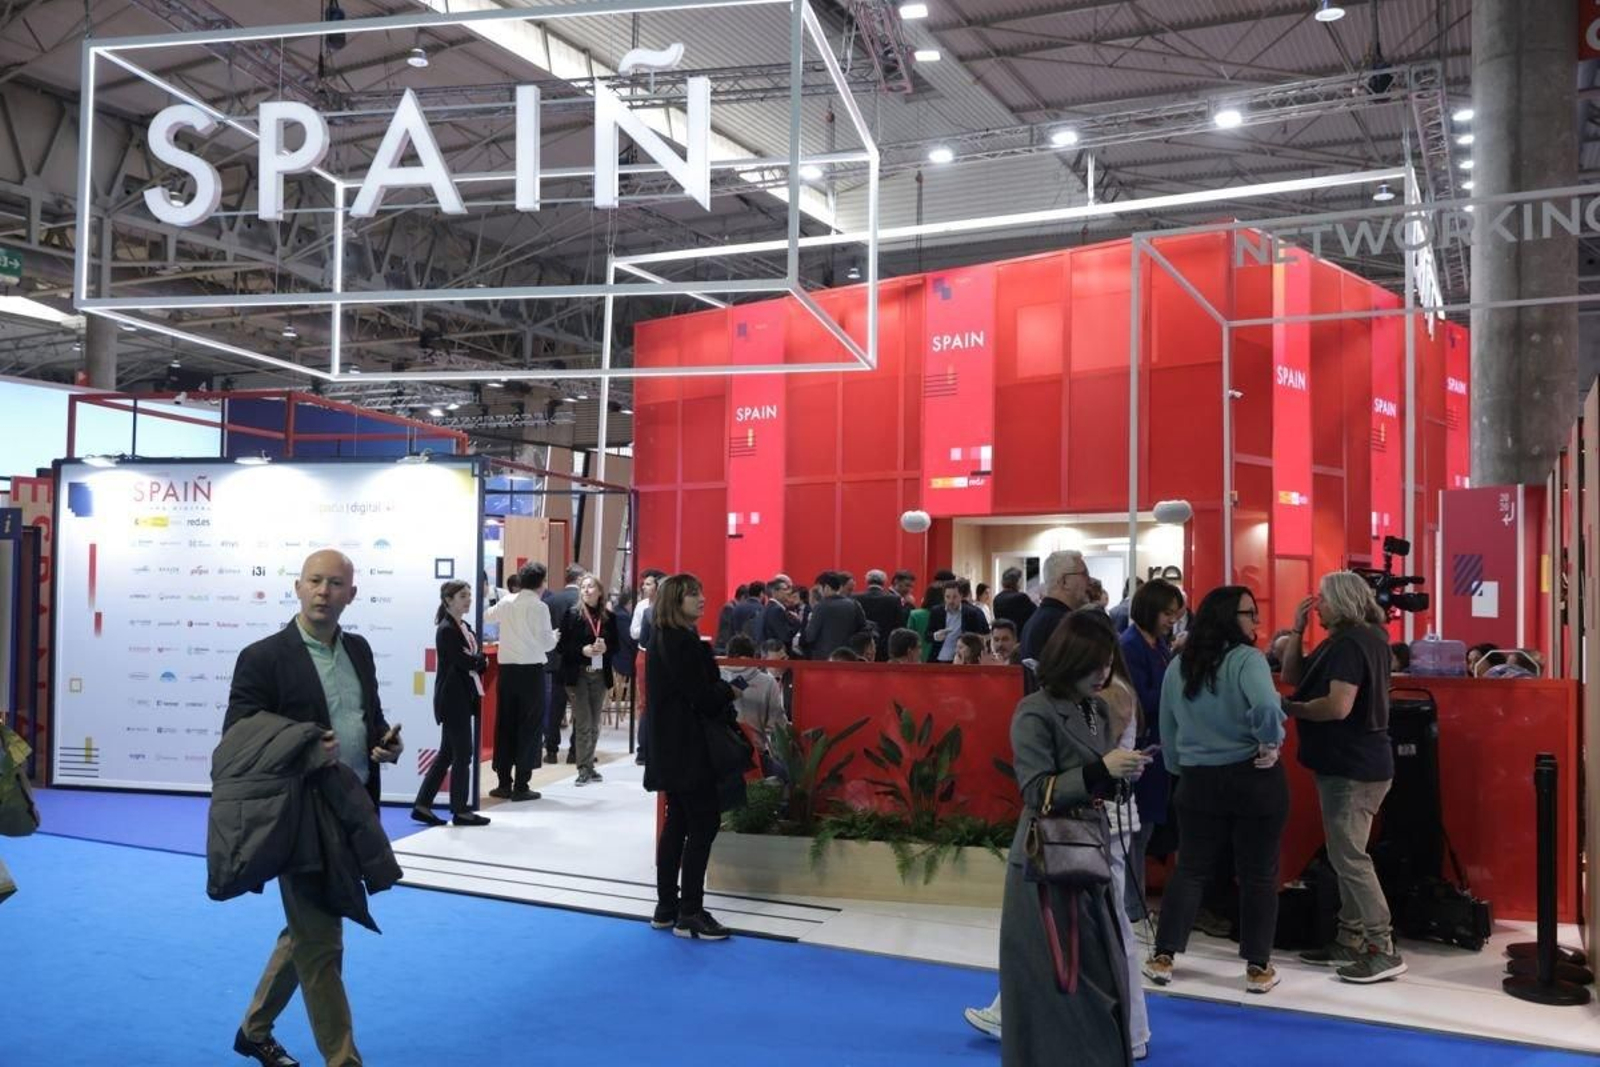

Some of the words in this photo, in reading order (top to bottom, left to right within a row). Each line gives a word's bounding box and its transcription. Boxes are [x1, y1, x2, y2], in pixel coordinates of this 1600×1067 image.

[143, 42, 712, 226] SPAIÑ
[932, 330, 984, 352] SPAIN
[1276, 364, 1306, 391] SPAIN
[1447, 376, 1467, 395] SPAIN
[736, 404, 777, 421] SPAIN
[1374, 397, 1397, 418] SPAIN
[252, 565, 266, 577] i3i
